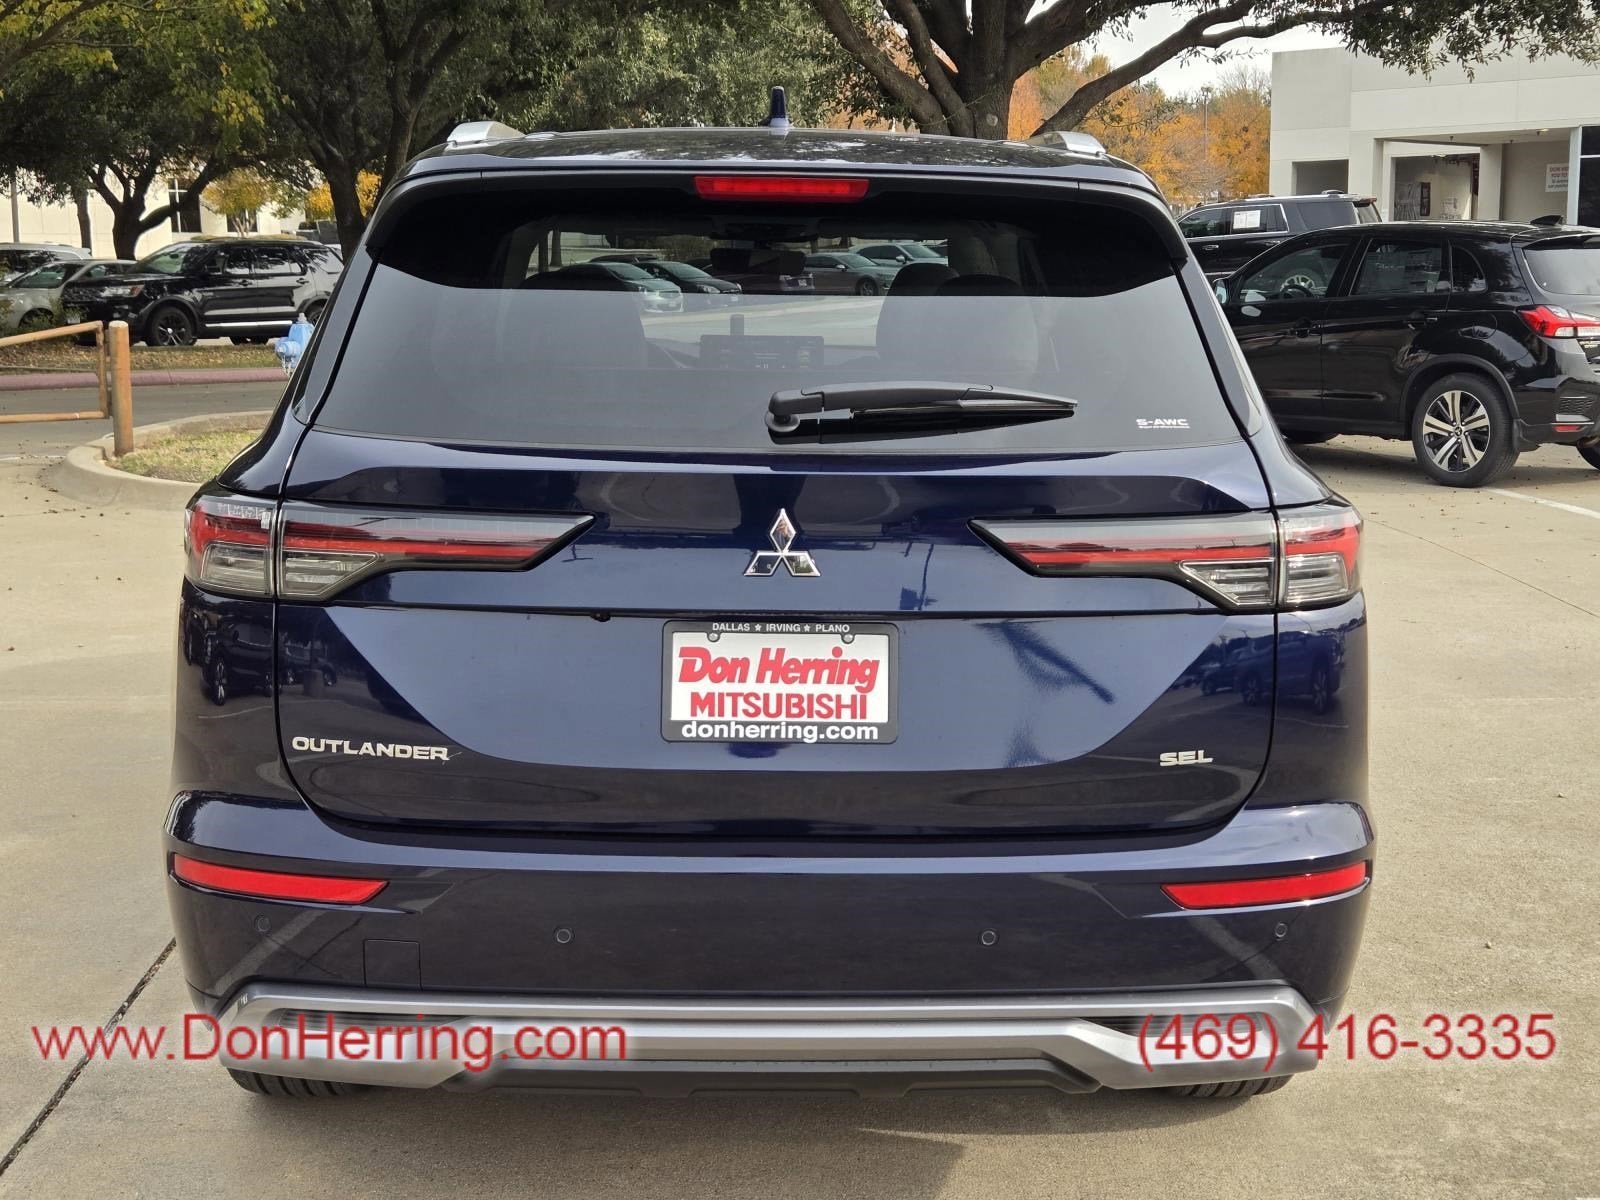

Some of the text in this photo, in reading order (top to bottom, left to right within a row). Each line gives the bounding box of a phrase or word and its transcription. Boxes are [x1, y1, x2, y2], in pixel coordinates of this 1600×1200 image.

[1136, 418, 1189, 426] S-AWC
[712, 622, 850, 633] DALLAS IRVING PLANO
[678, 646, 881, 694] Don Herring
[690, 691, 868, 720] MITSUBISHI
[681, 720, 879, 744] donherring.com
[291, 736, 450, 761] OUTLANDER
[1159, 749, 1214, 767] SEL
